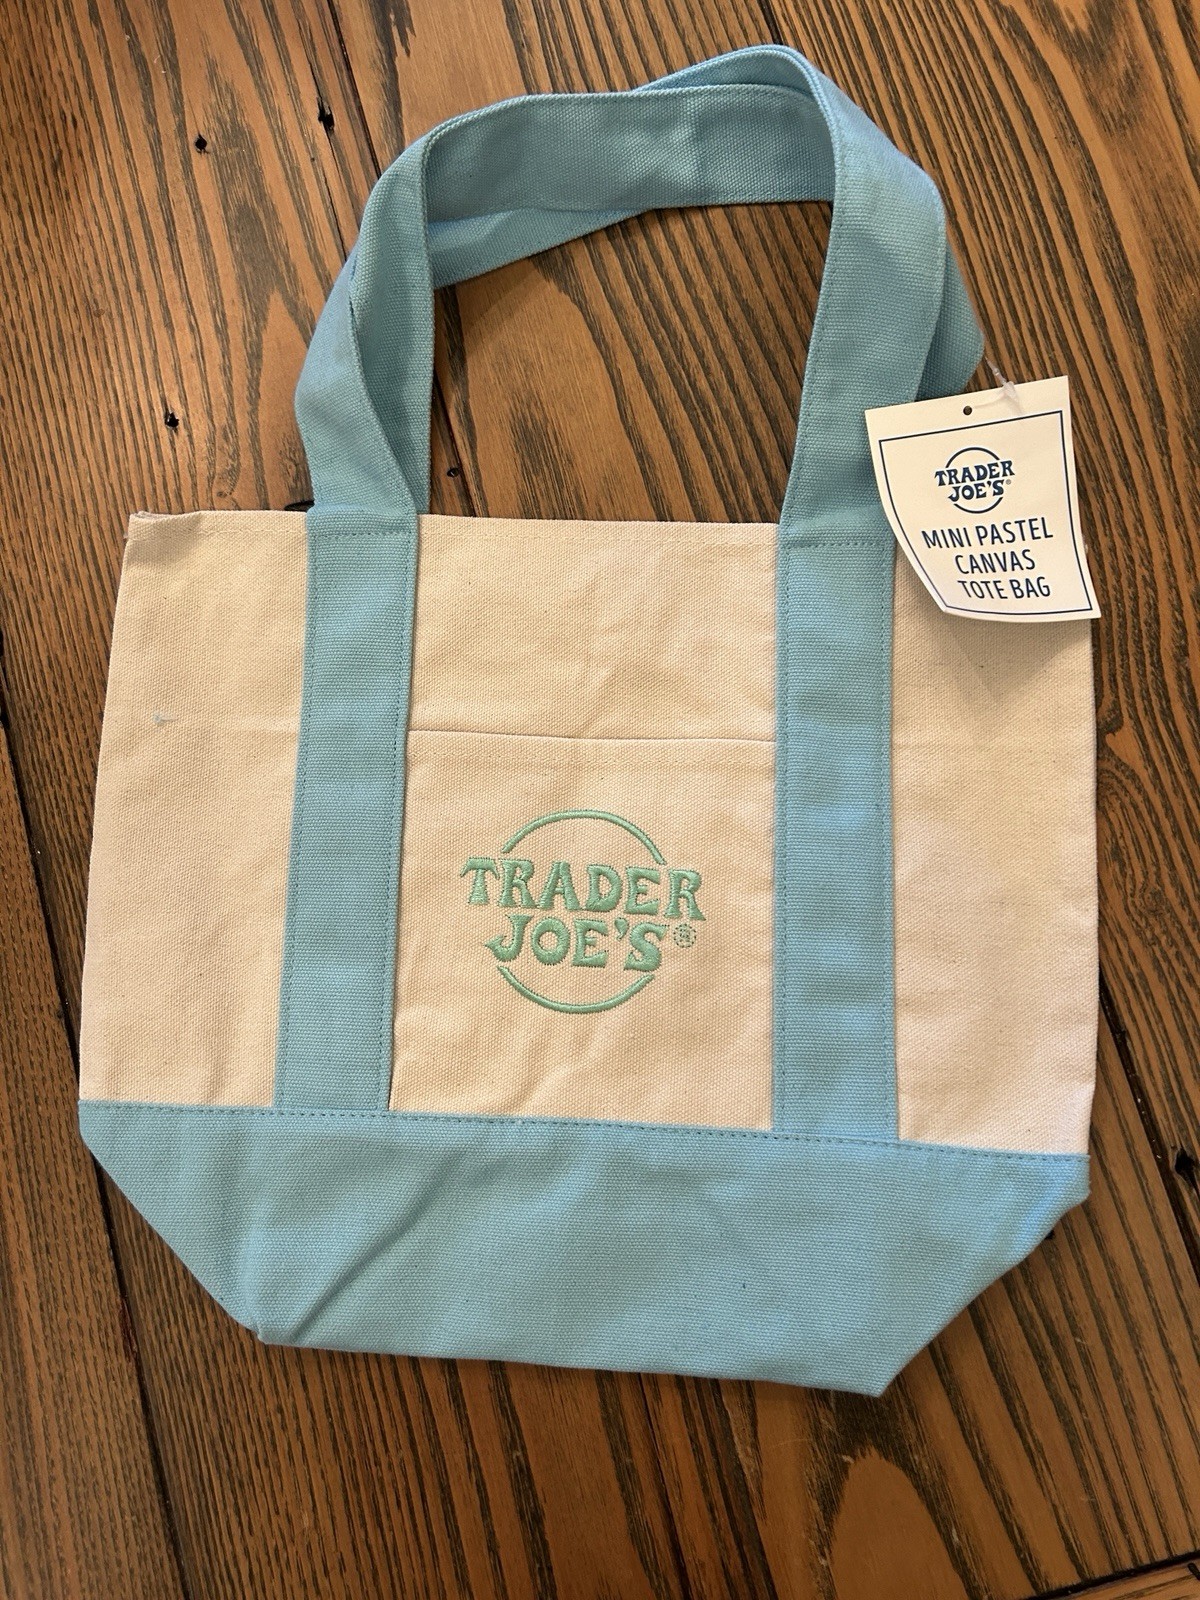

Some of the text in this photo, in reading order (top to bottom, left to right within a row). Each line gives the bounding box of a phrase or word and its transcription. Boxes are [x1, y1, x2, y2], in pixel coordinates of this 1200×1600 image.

[935, 460, 1015, 487] TRADER
[948, 479, 1005, 502] JOE'S
[921, 517, 1053, 549] MINI PASTEL
[955, 549, 1036, 575] CANVAS
[957, 576, 1051, 599] TOTE BAG
[460, 857, 706, 921] TRADER
[484, 914, 669, 972] JOE'S
